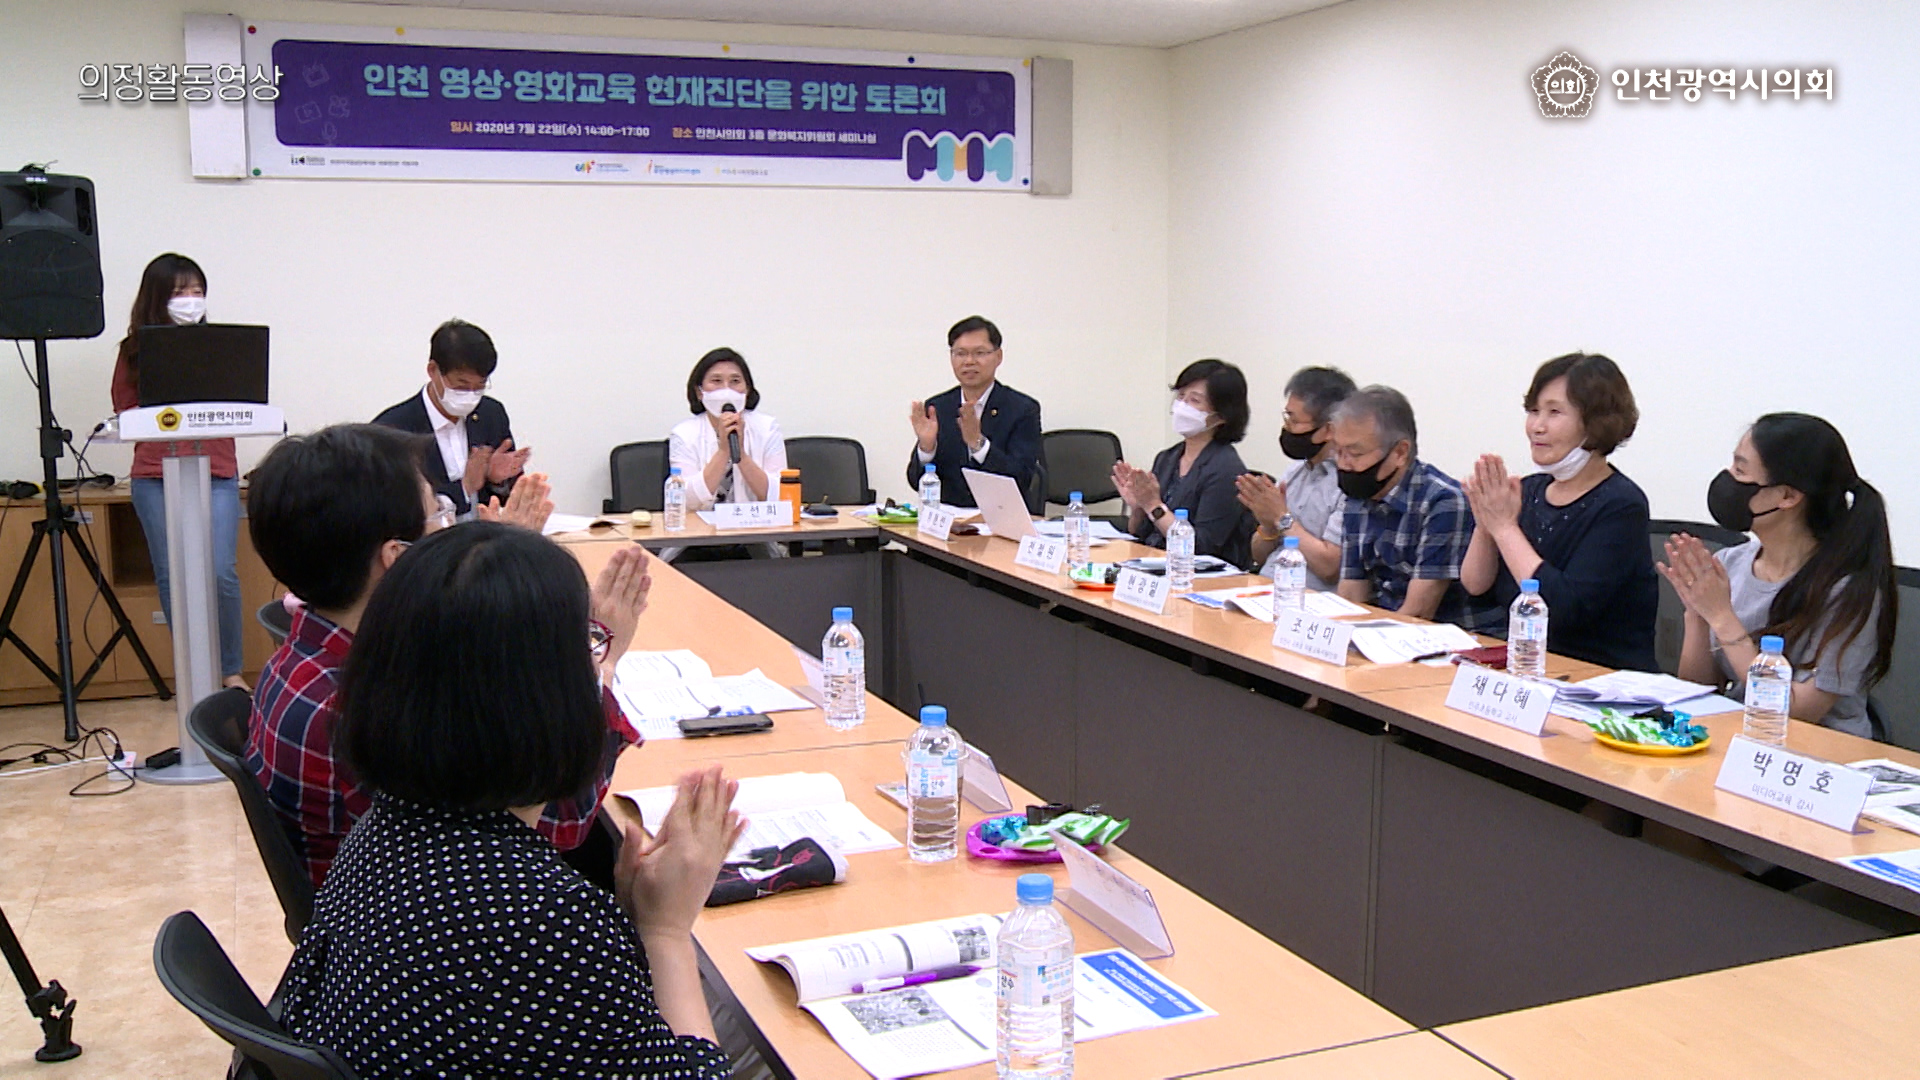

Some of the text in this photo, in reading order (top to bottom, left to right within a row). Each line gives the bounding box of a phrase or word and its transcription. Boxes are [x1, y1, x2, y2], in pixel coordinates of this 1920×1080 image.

[363, 64, 430, 98] 인천
[646, 75, 793, 110] 현재진단을
[801, 81, 858, 112] 위한
[865, 84, 947, 116] 토론회
[475, 122, 515, 135] 2020년
[517, 123, 536, 136] 7월
[187, 411, 253, 422] 인천광역시의회
